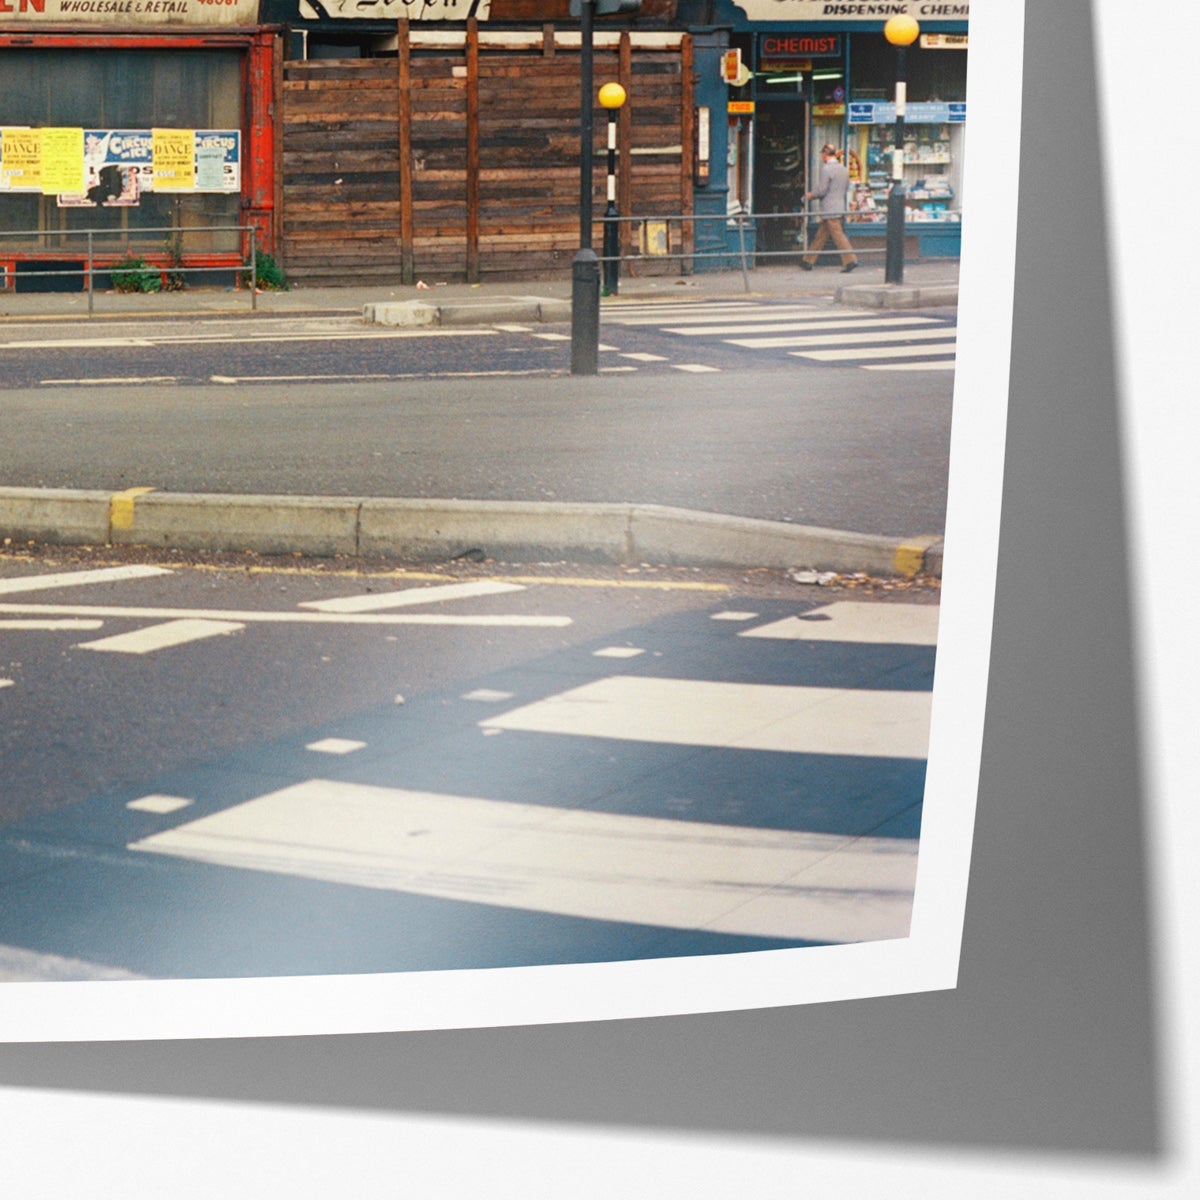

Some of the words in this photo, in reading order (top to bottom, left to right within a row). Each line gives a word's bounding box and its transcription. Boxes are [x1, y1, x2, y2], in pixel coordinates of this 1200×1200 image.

[60, 1, 132, 13] WHOLESALE
[145, 1, 189, 13] RETAIL
[822, 4, 908, 16] DISPENSING
[764, 37, 837, 53] CHEMIST
[3, 143, 41, 154] DANCE
[154, 144, 192, 155] DANCE
